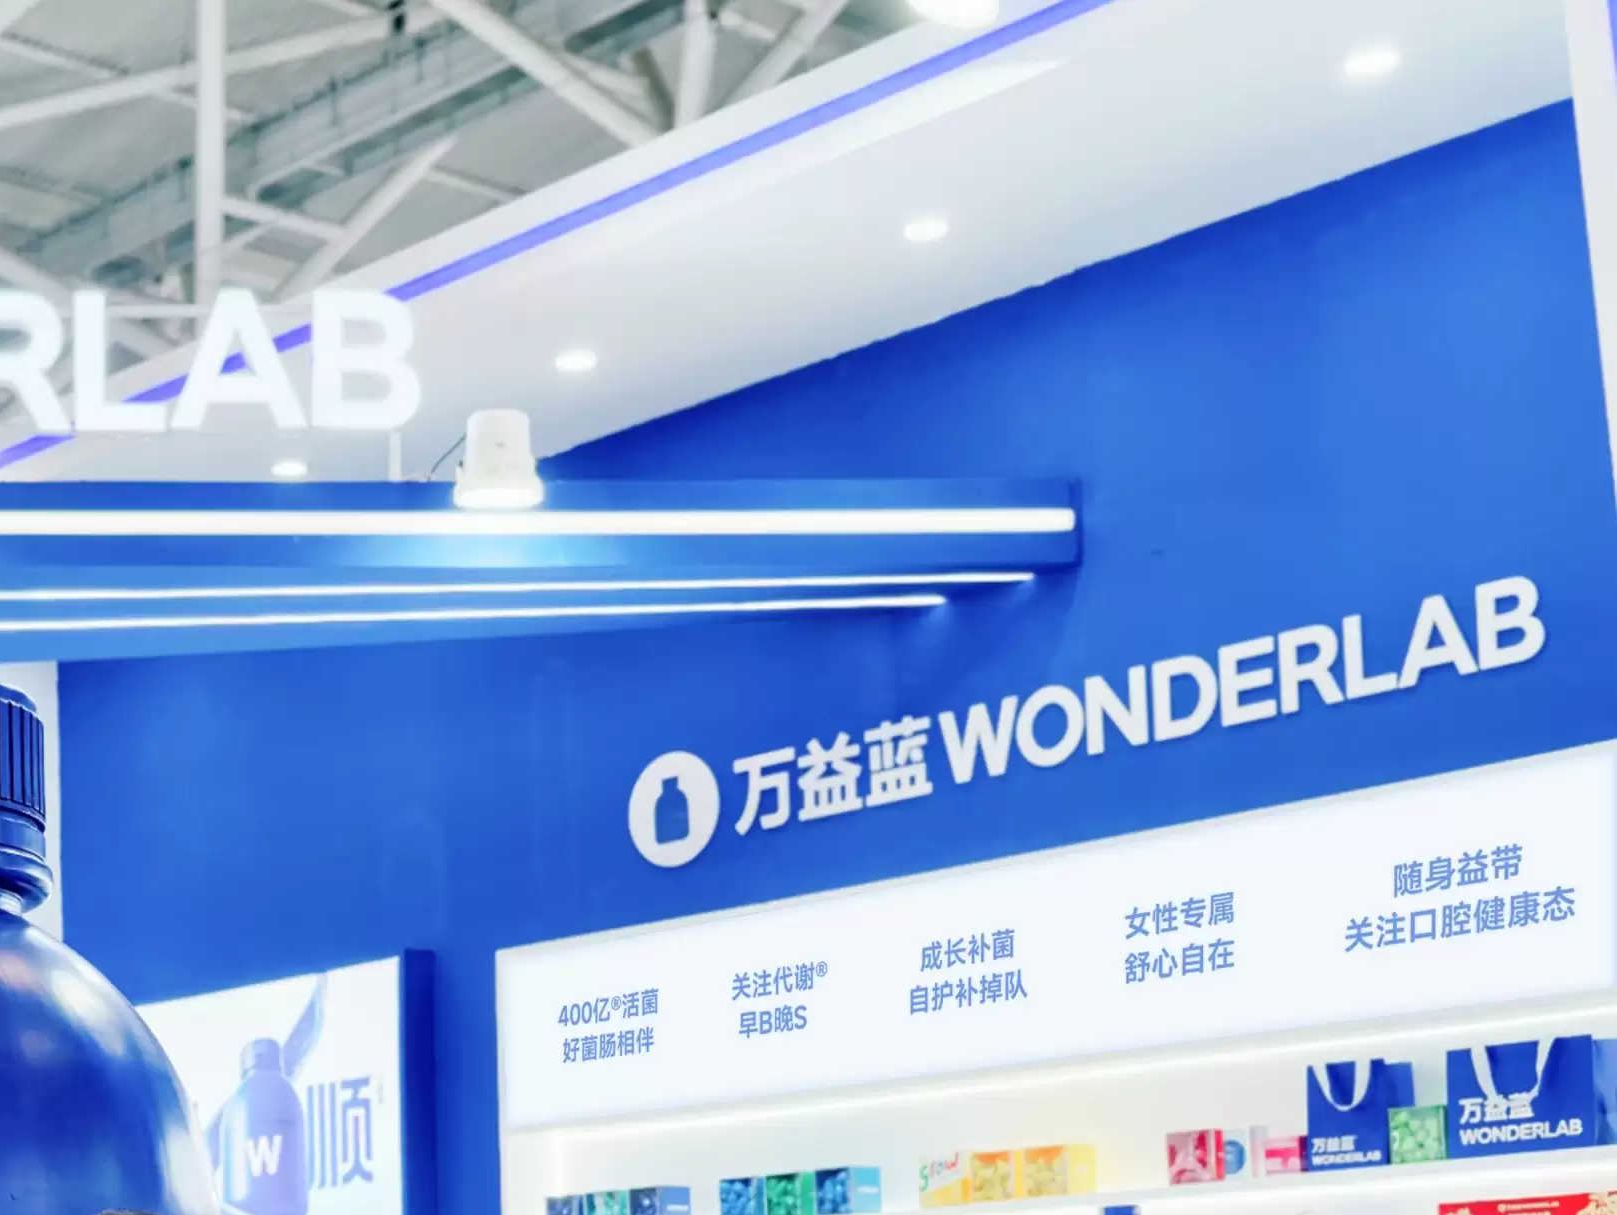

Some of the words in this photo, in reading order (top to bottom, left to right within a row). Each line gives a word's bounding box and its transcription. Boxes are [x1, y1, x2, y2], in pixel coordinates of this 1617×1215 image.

[731, 715, 933, 838] 万益蓝
[936, 574, 1547, 786] WONDERLAB
[1392, 843, 1524, 898] 随身益带
[1124, 891, 1236, 940] 女性专属
[1344, 886, 1577, 953] 关注口腔健康态
[919, 927, 1016, 972] 成长补菌
[1124, 937, 1236, 985] 舒心自在
[908, 968, 1028, 1016] 自护补掉队
[562, 1025, 656, 1064] 好菌肠相伴
[738, 1004, 808, 1039] 早B晚S
[246, 1134, 283, 1178] W
[1459, 1118, 1583, 1146] WONDERLAB
